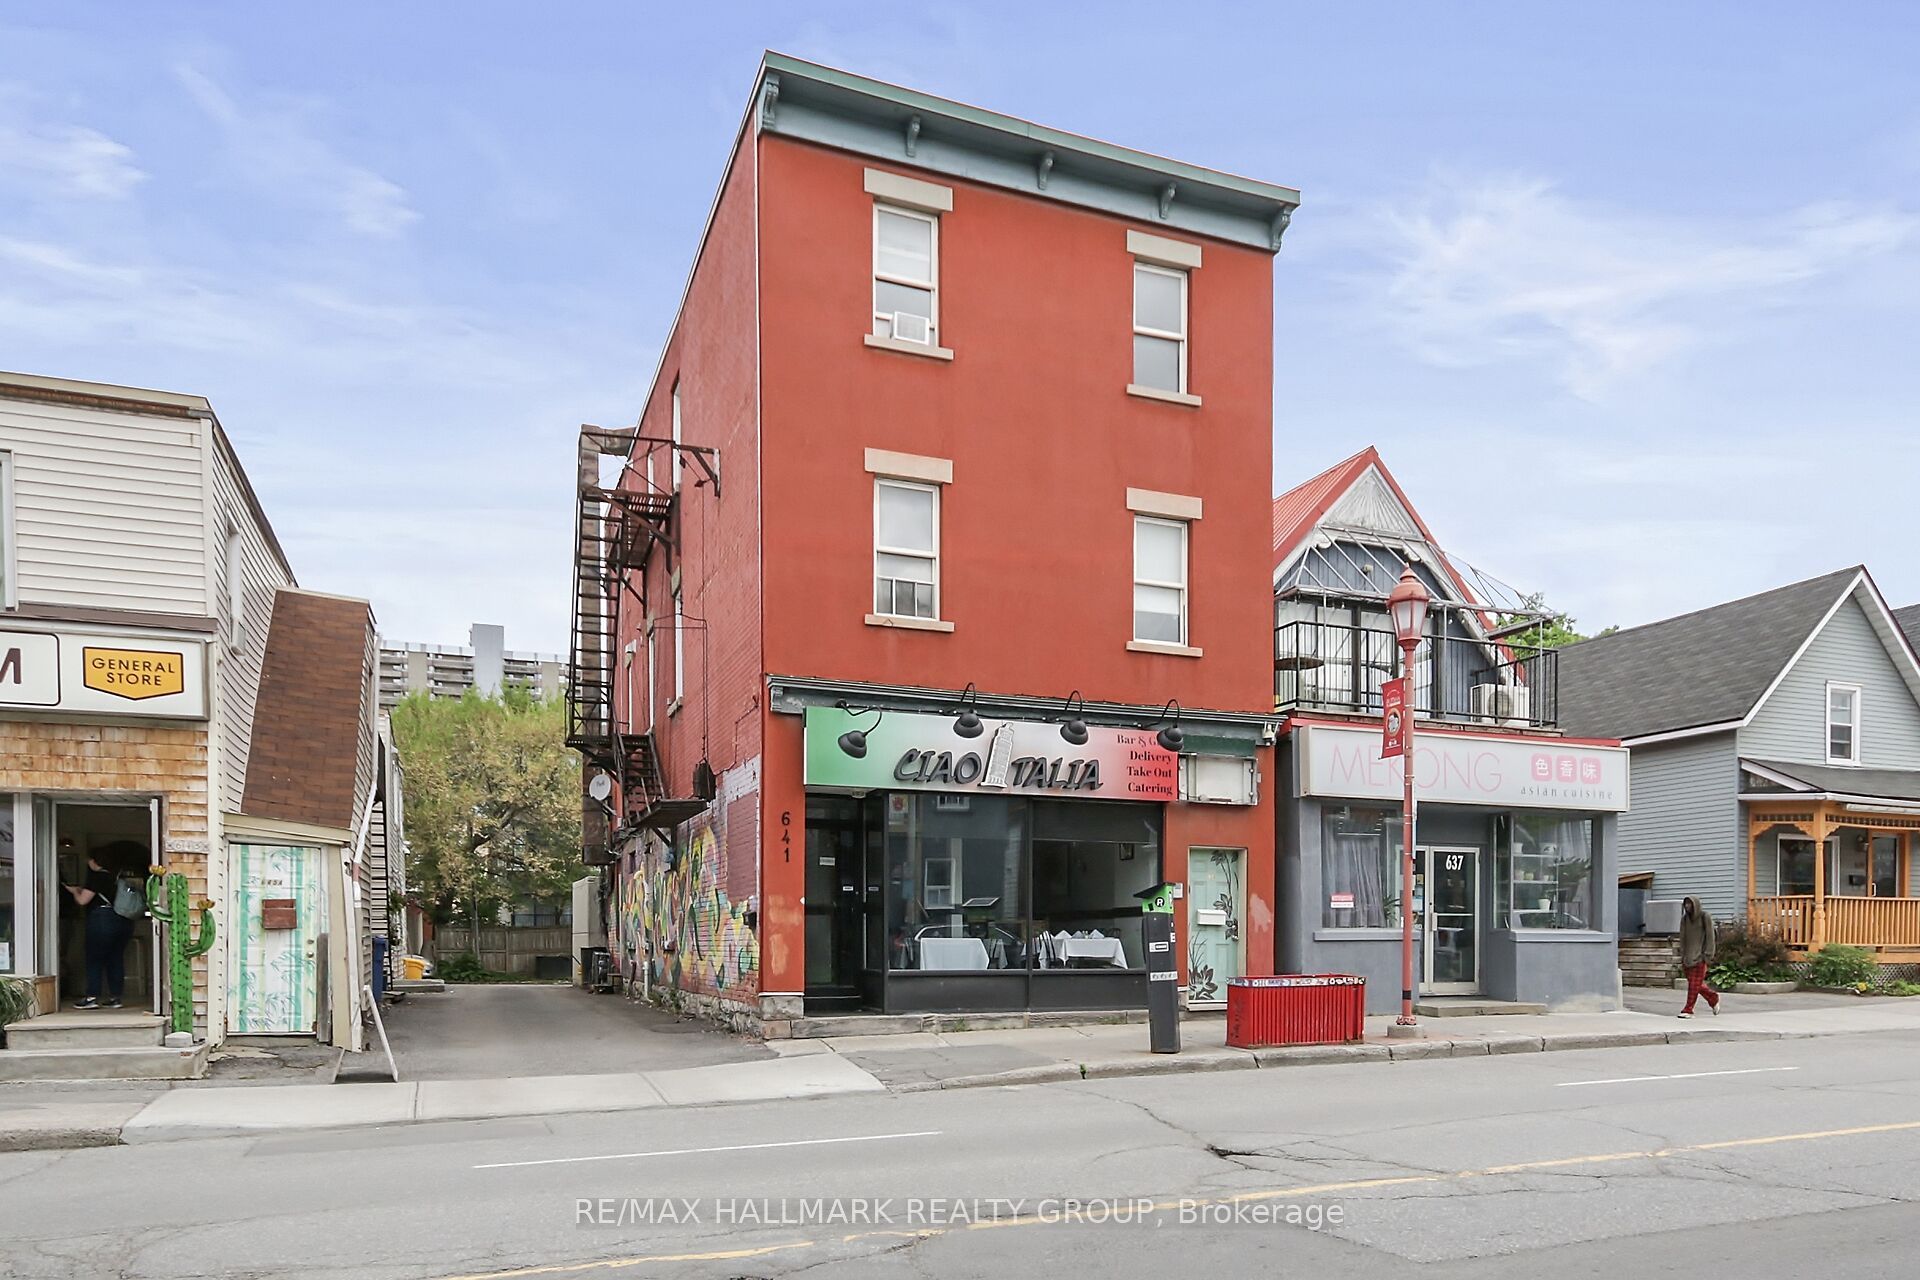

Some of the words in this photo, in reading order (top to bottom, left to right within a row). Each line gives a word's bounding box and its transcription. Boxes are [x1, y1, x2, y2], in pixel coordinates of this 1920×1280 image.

[92, 657, 175, 674] GENERAL
[106, 672, 163, 686] STORE
[1117, 734, 1136, 745] Bar
[1138, 736, 1147, 748] &
[1130, 750, 1172, 765] Delivery
[893, 748, 982, 785] CIAO
[1127, 766, 1152, 777] Take
[1153, 767, 1172, 778] Out
[1535, 758, 1597, 779] 色香味
[1128, 782, 1173, 796] Catering
[1521, 786, 1557, 797] asian
[1563, 788, 1613, 800] cuisine
[781, 811, 790, 863] 641
[1445, 854, 1464, 871] 637
